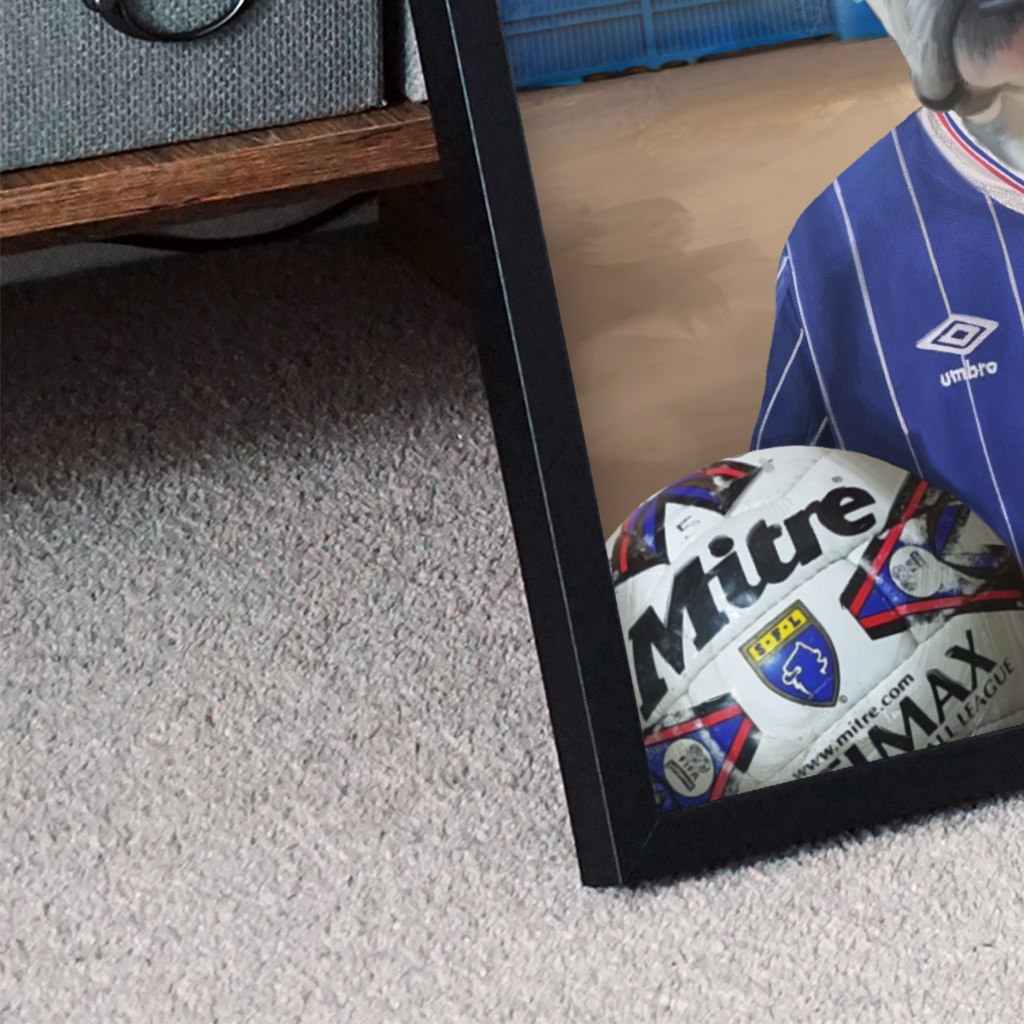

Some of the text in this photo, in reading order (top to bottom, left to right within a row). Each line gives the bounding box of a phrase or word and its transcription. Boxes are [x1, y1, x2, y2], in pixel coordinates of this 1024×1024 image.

[940, 359, 998, 387] umbro
[628, 486, 877, 722] Mitre
[825, 629, 997, 768] MAX
[956, 656, 1015, 727] LEAGUE
